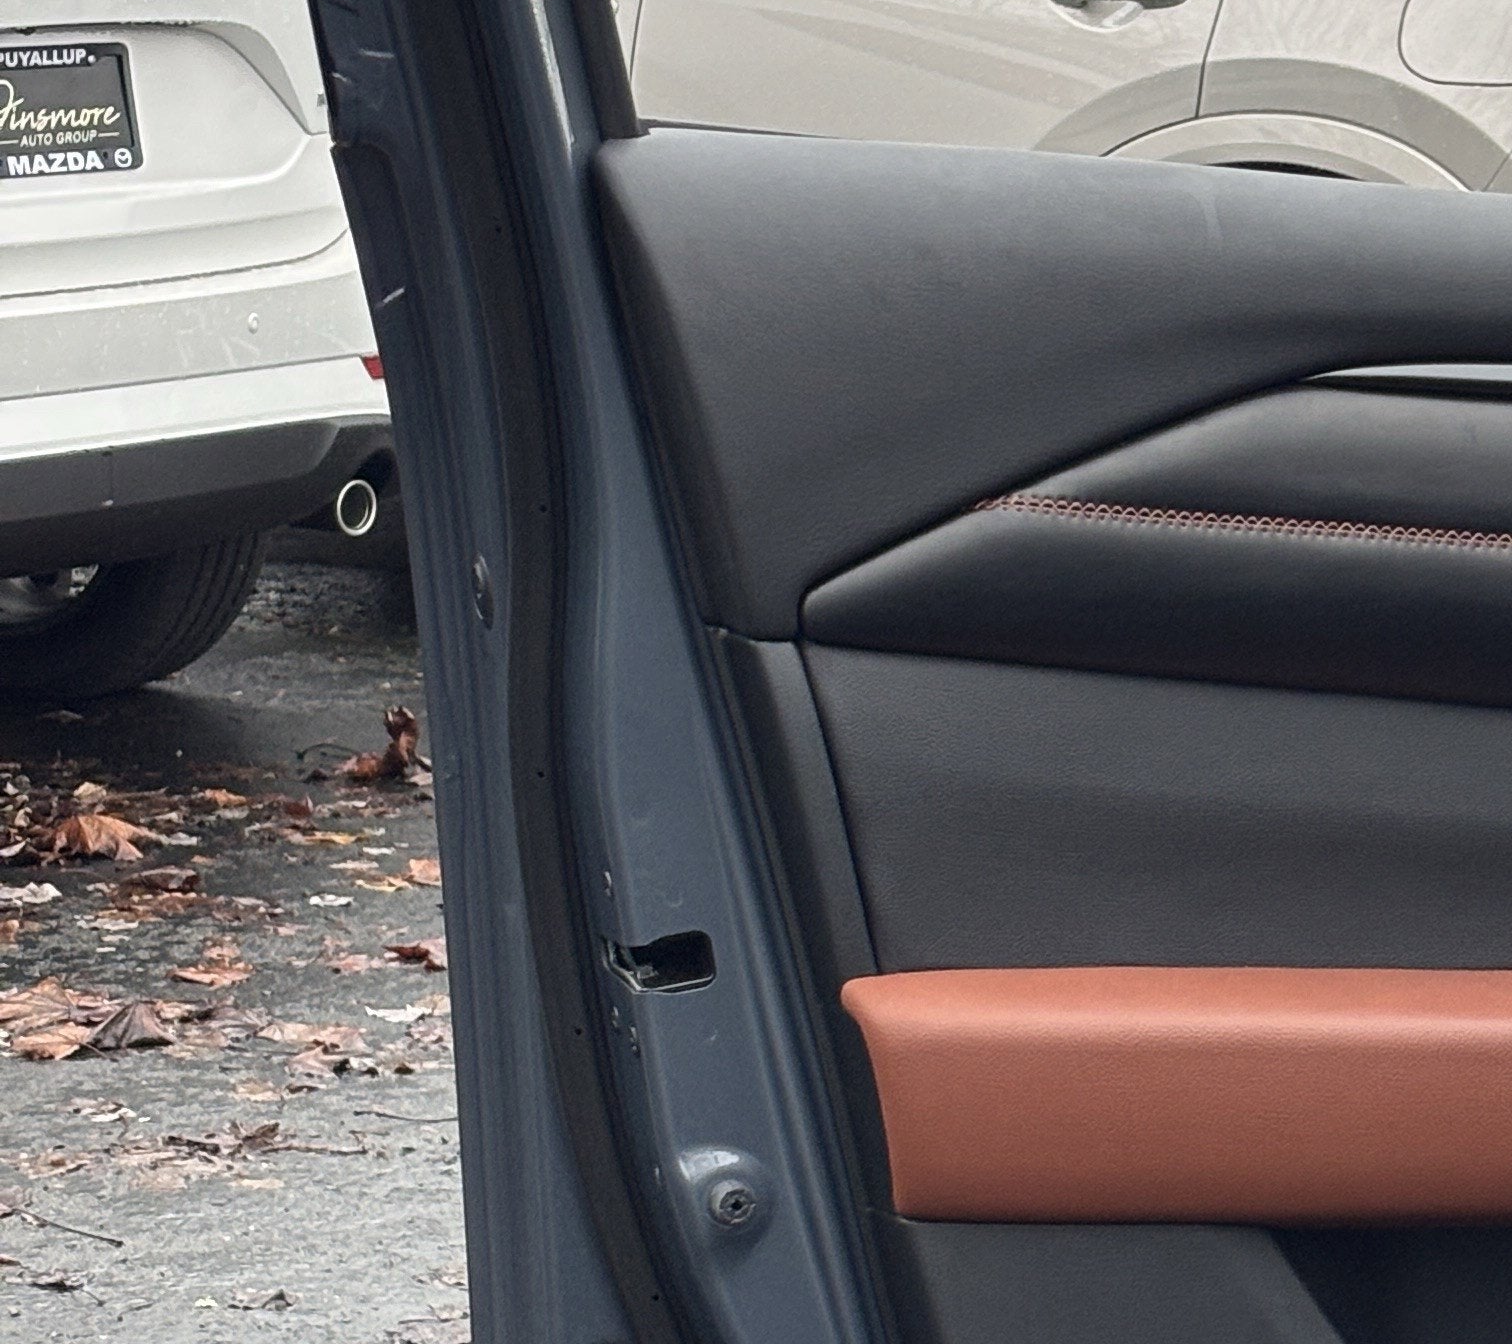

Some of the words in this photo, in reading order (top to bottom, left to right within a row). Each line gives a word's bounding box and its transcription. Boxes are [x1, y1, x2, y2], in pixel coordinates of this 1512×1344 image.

[20, 133, 53, 148] AUTO
[56, 130, 97, 145] GROUP
[7, 151, 104, 176] MAZDA
